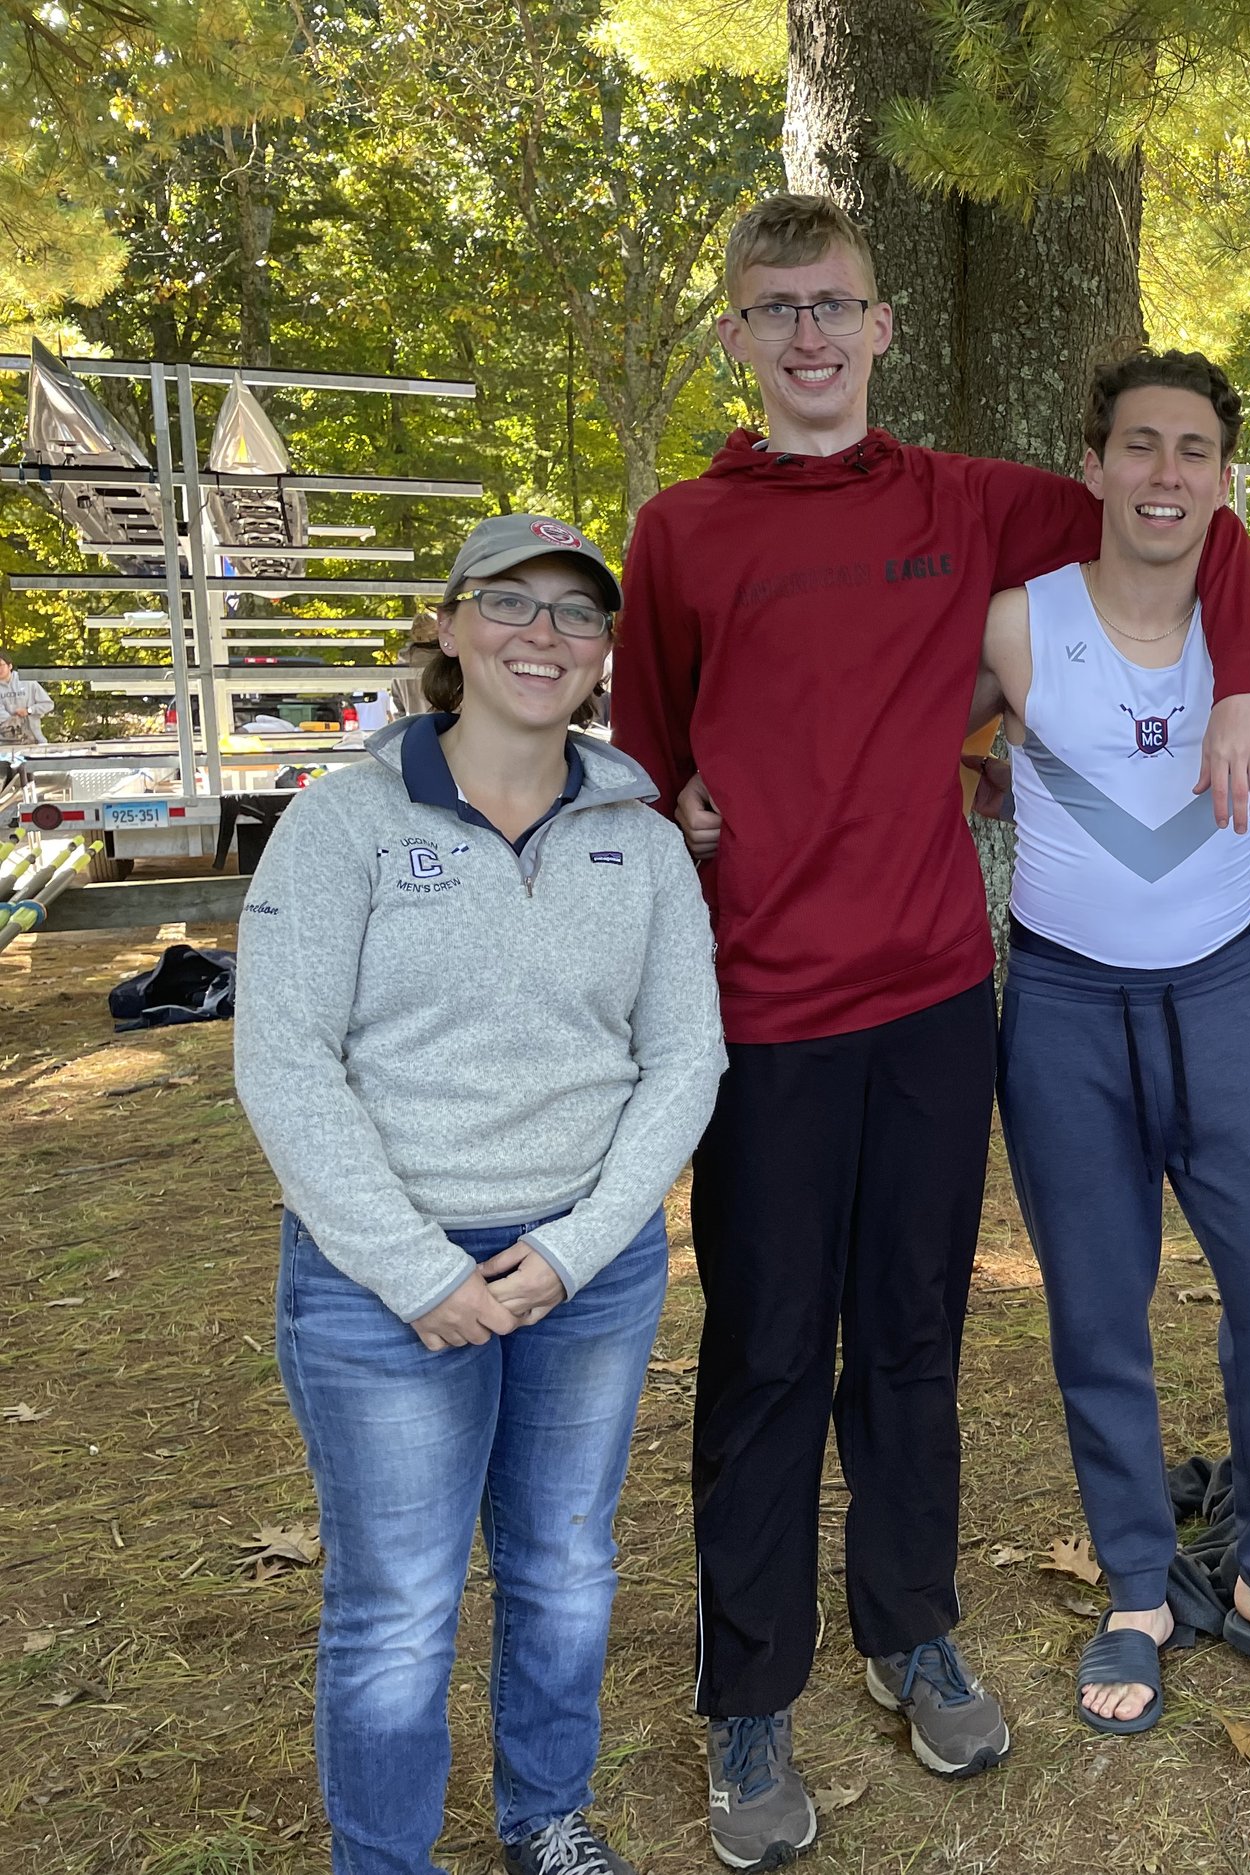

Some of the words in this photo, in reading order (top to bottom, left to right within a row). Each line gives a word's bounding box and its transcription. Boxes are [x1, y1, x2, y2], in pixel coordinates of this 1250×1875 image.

[885, 553, 954, 583] EAGLE
[1141, 721, 1163, 734] UC
[1141, 733, 1163, 747] MC
[396, 879, 431, 893] MEN'S
[433, 877, 461, 893] CREW
